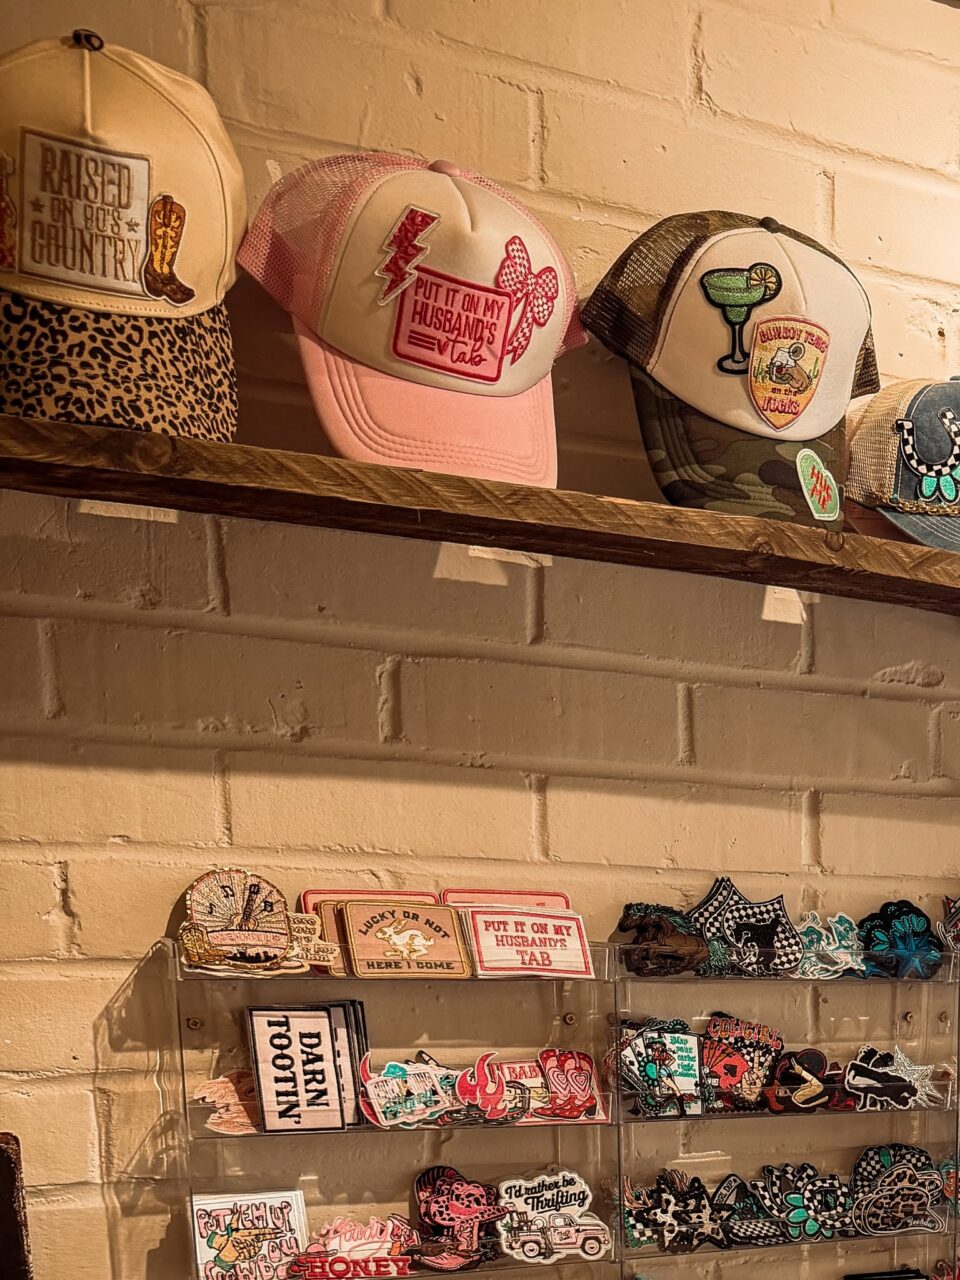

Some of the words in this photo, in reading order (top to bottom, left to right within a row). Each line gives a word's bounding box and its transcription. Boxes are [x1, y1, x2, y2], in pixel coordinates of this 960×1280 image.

[40, 142, 132, 210] RAISED
[51, 197, 75, 225] ON
[84, 204, 122, 235] 90'S
[30, 221, 142, 283] COUNTRY
[415, 277, 442, 303] PUT
[445, 288, 459, 308] IT
[462, 293, 480, 315] ON
[483, 298, 505, 320] MY
[411, 299, 497, 345] HUSBAND'S
[758, 326, 802, 344] COWBOY
[445, 335, 488, 366] tab
[771, 388, 782, 396] on
[784, 387, 800, 396] the
[358, 910, 396, 936] LUCKY
[402, 910, 421, 923] OR
[423, 918, 450, 939] NOT
[483, 920, 510, 932] PUT
[514, 921, 527, 932] IT
[530, 922, 549, 934] ON
[553, 925, 572, 937] MY
[495, 934, 568, 948] HUSBAND'S
[366, 961, 402, 970] HERE
[407, 961, 411, 970] I
[417, 961, 455, 970] COME
[516, 950, 553, 967] TAB
[707, 1016, 782, 1050] COWGIRL
[267, 1015, 302, 1125] TOOTIN'
[299, 1031, 330, 1107] DARN
[505, 1185, 524, 1199] I'd
[524, 1179, 561, 1195] rather
[561, 1175, 577, 1188] be
[524, 1190, 589, 1212] Thrifting
[196, 1209, 232, 1239] PUT
[233, 1203, 268, 1230] 'EM
[307, 1256, 412, 1278] HONEY
